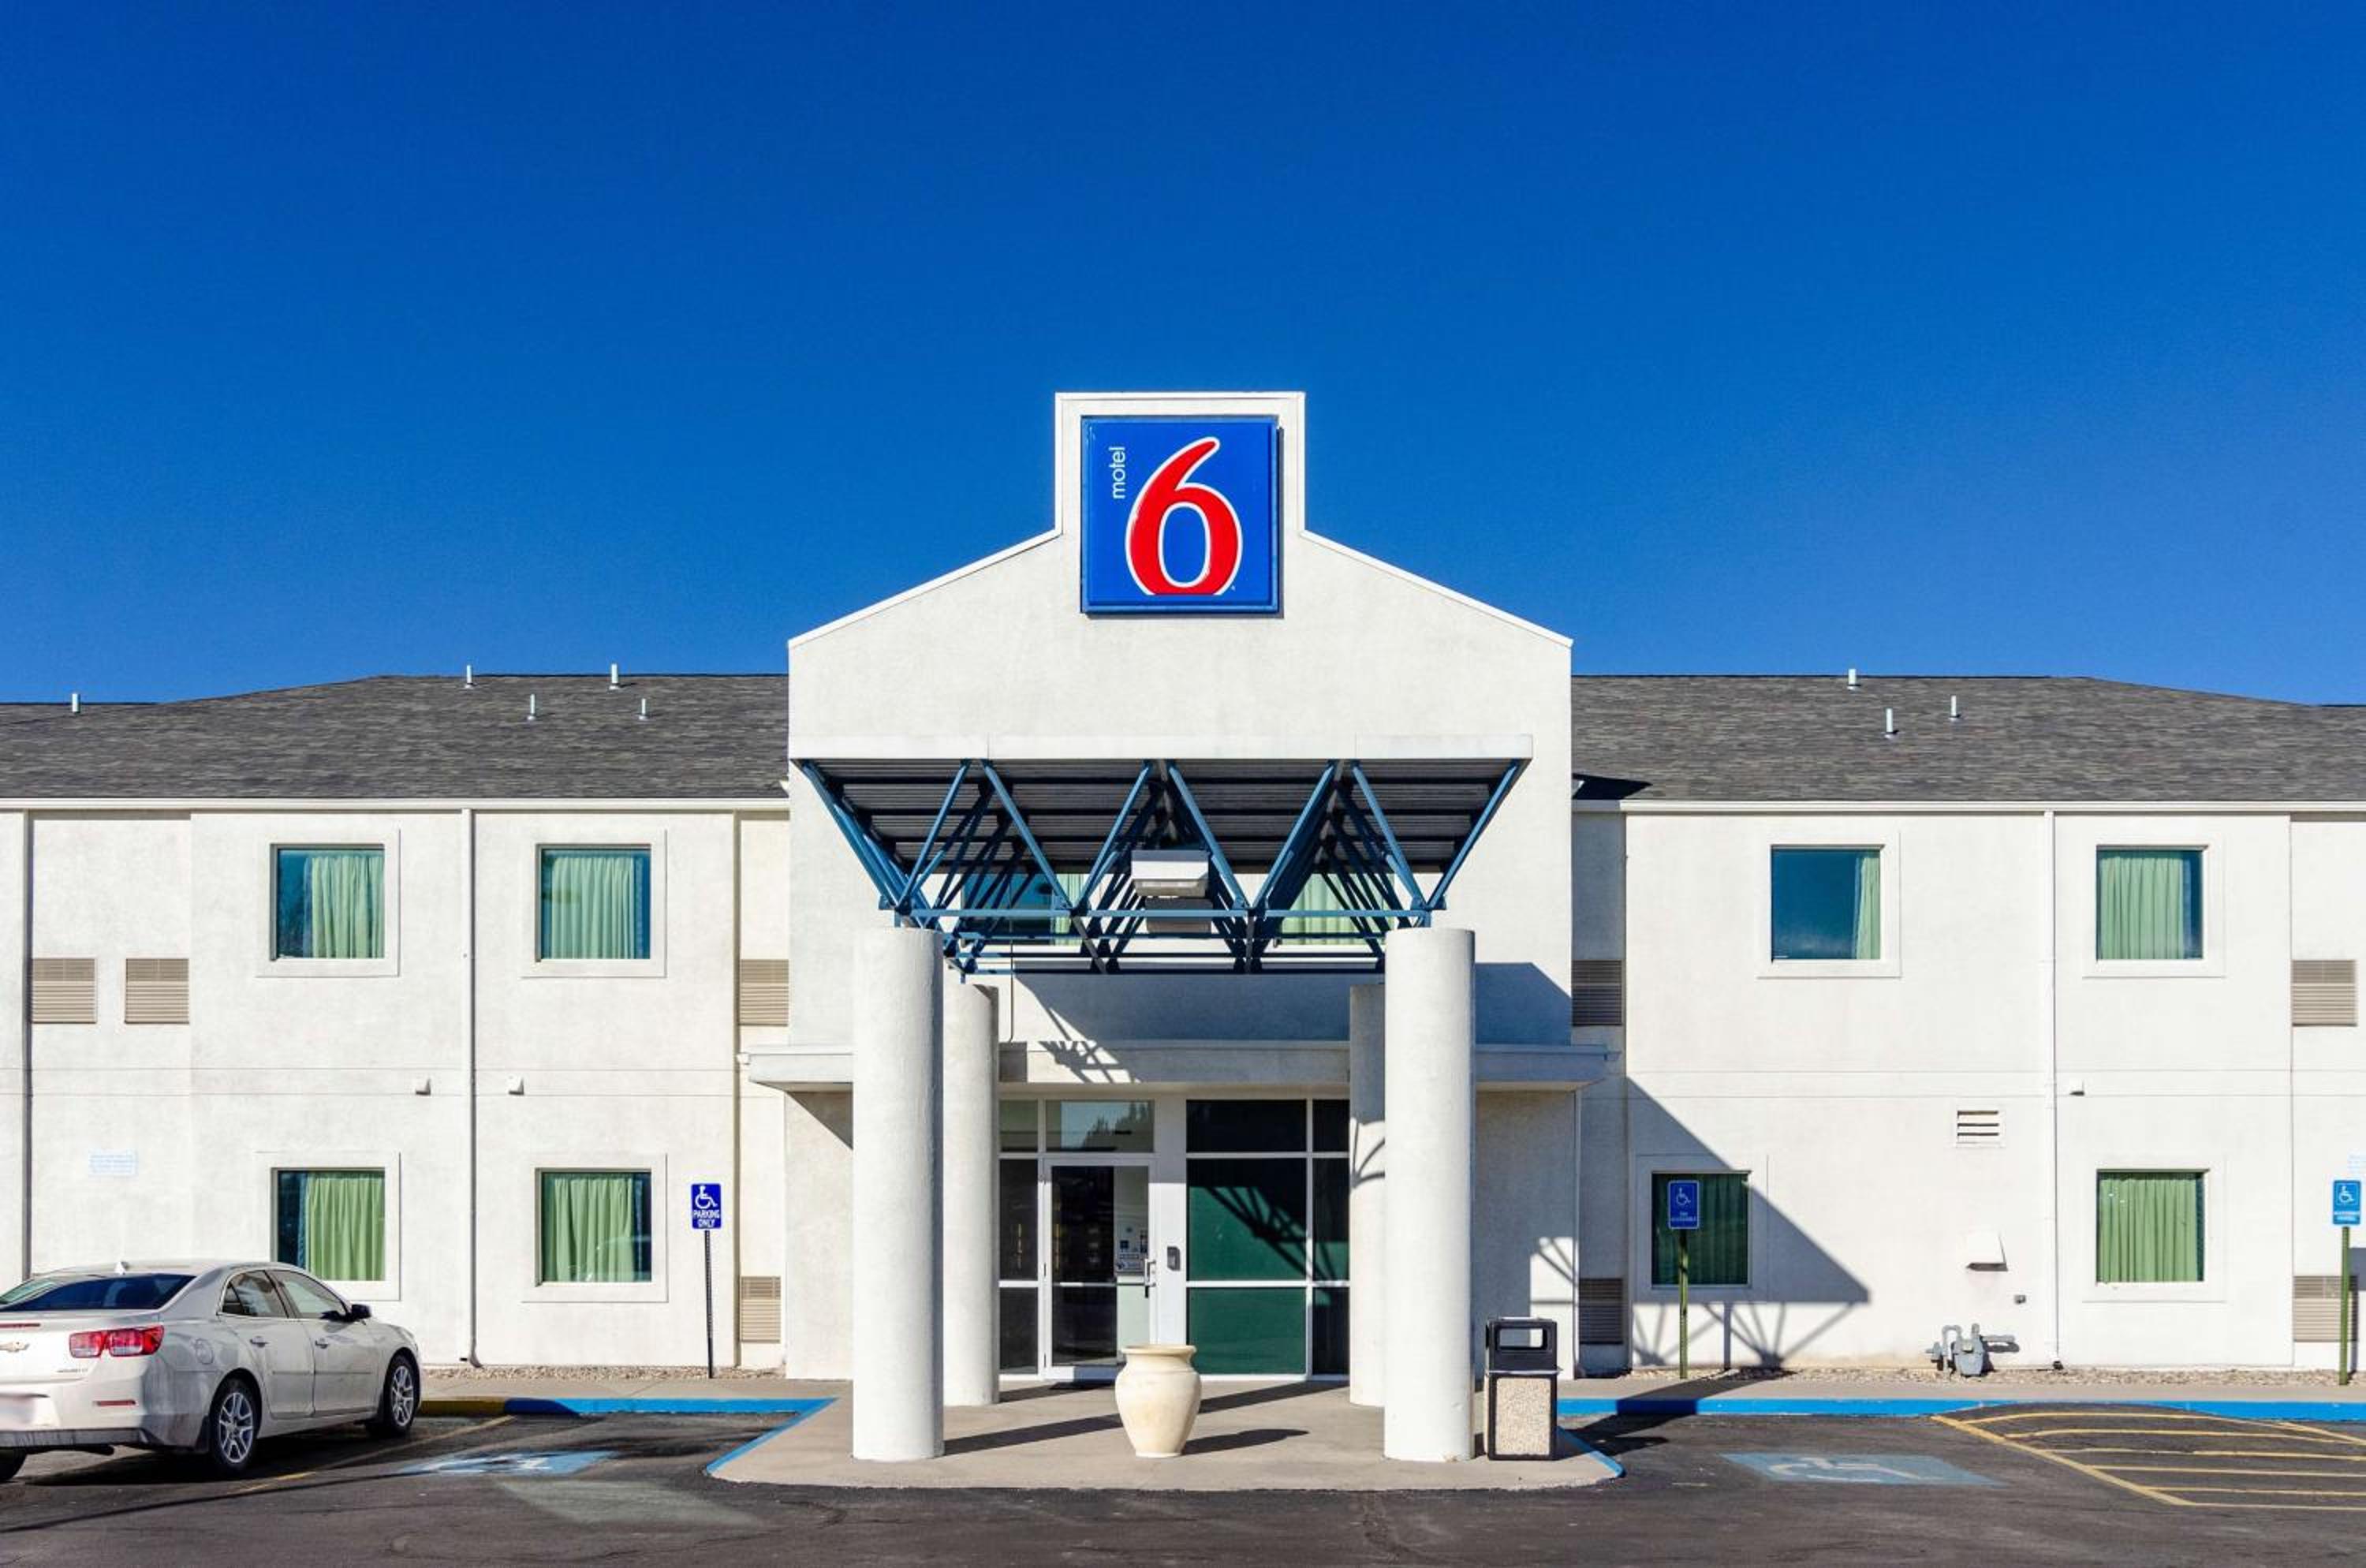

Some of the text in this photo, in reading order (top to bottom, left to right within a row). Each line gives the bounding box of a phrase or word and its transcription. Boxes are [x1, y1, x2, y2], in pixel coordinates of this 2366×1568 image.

[1108, 446, 1125, 499] motel
[1125, 436, 1243, 595] 6
[692, 1209, 720, 1219] PARKING
[697, 1219, 715, 1228] ONLY
